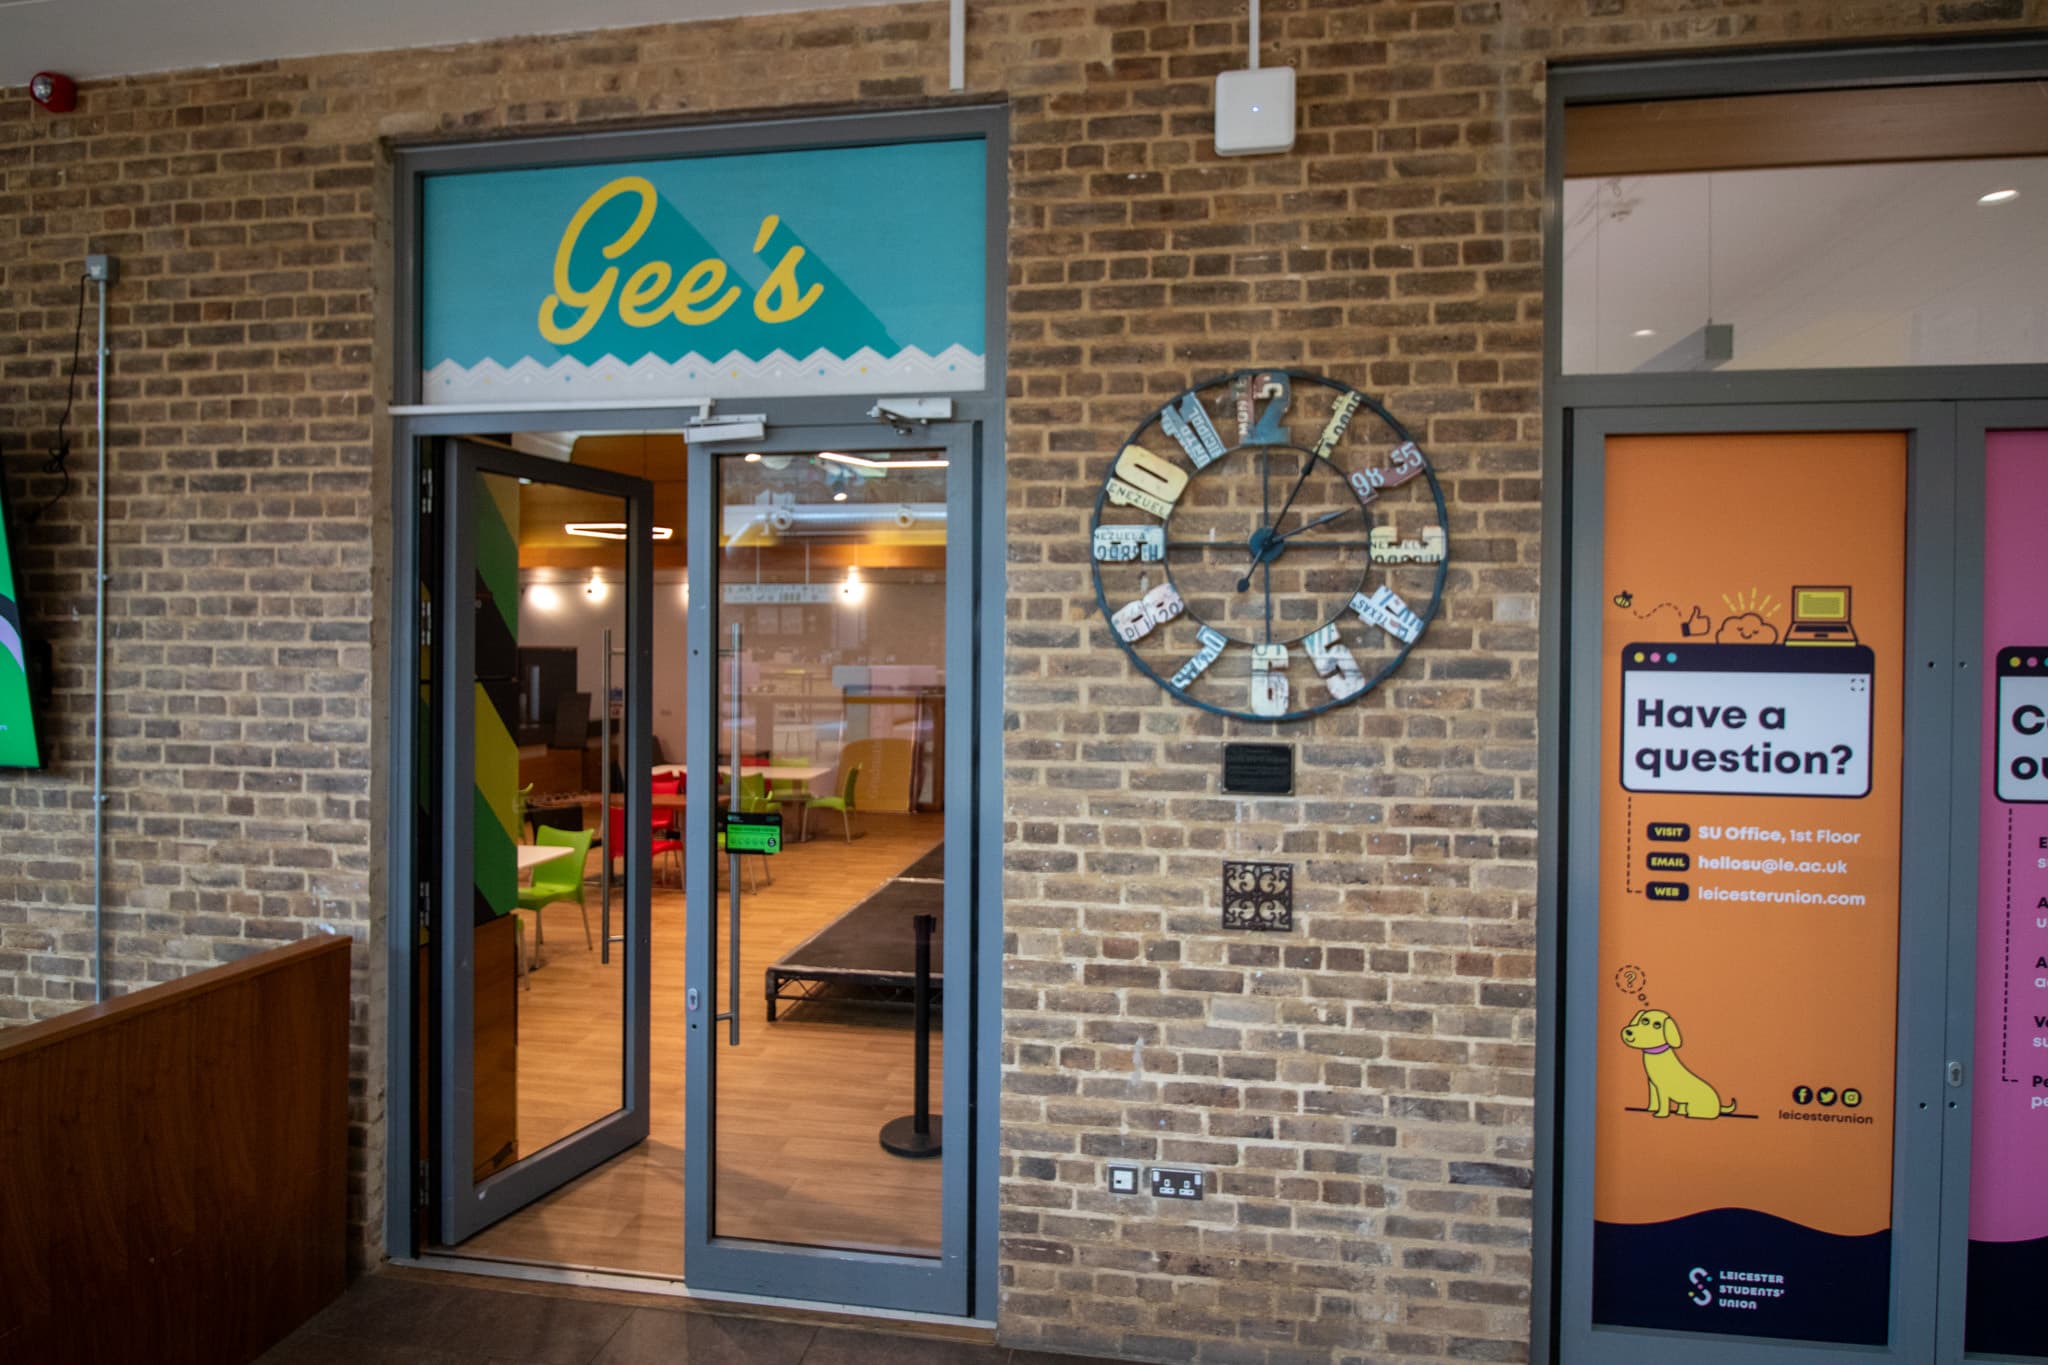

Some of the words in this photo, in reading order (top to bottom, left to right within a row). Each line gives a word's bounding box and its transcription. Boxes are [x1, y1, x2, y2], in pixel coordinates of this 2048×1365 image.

[538, 175, 825, 346] Gee's
[1637, 698, 1747, 729] Have
[1759, 706, 1786, 730] a
[2012, 704, 2048, 735] C
[1635, 742, 1853, 778] question?
[1654, 827, 1683, 837] VISIT
[1698, 825, 1722, 840] SU
[1725, 826, 1786, 844] Office,
[1790, 829, 1812, 842] 1st
[1816, 830, 1861, 844] Floor
[1650, 857, 1685, 868] EMAIL
[1698, 856, 1847, 874] hellosu@le.ac.uk
[1654, 887, 1680, 897] WEB
[1698, 887, 1866, 906] leicesterunion.com
[1778, 1110, 1874, 1125] leicesterunion
[1719, 1271, 1784, 1283] LEICESTER
[1719, 1298, 1757, 1310] UNION
